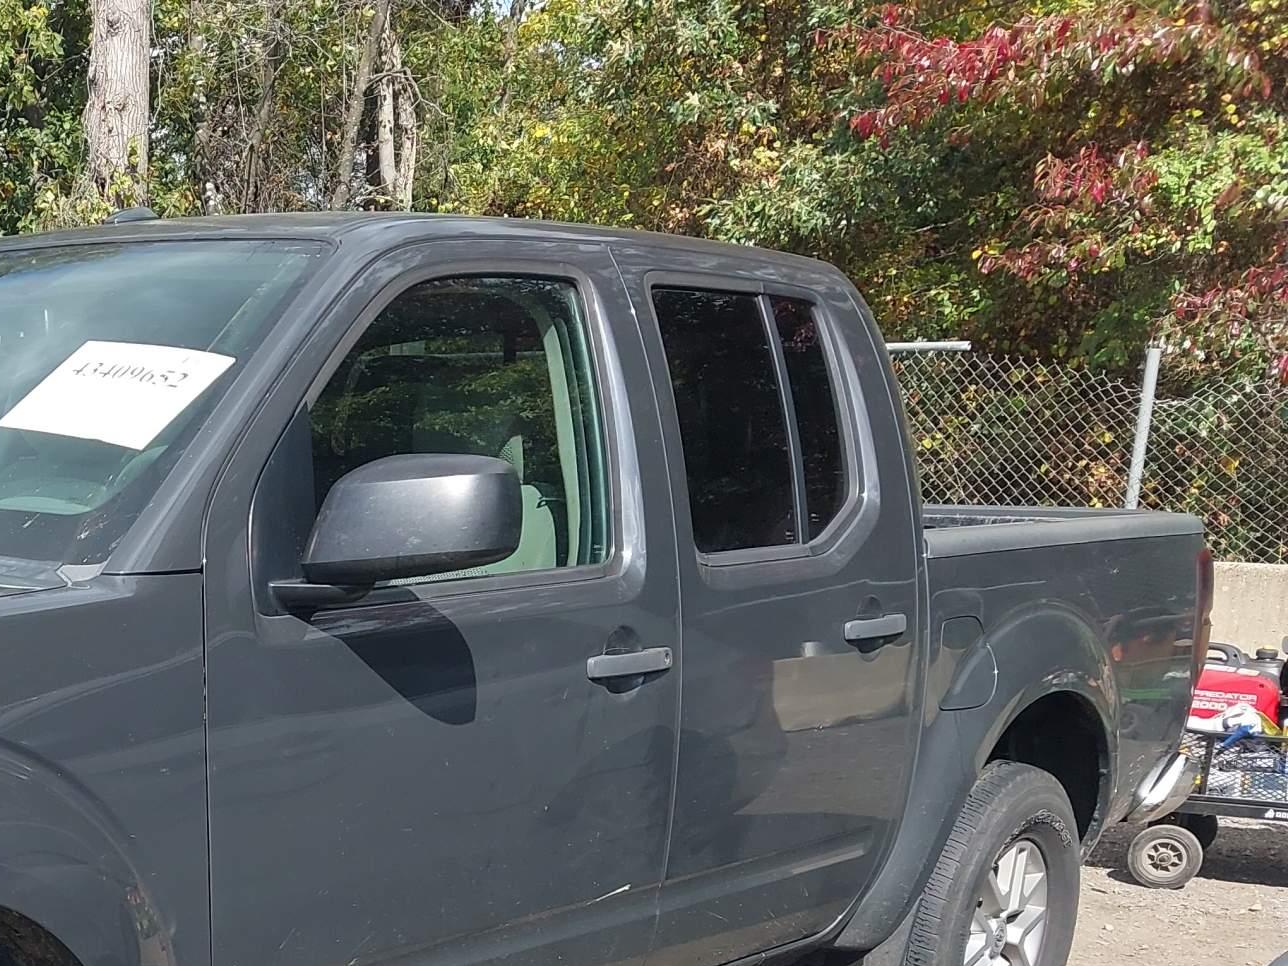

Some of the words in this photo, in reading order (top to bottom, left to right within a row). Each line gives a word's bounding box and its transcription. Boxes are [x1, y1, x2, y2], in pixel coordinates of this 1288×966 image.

[73, 361, 189, 388] 43409652
[1194, 689, 1257, 703] PREDATOR
[1192, 700, 1228, 712] 2000
